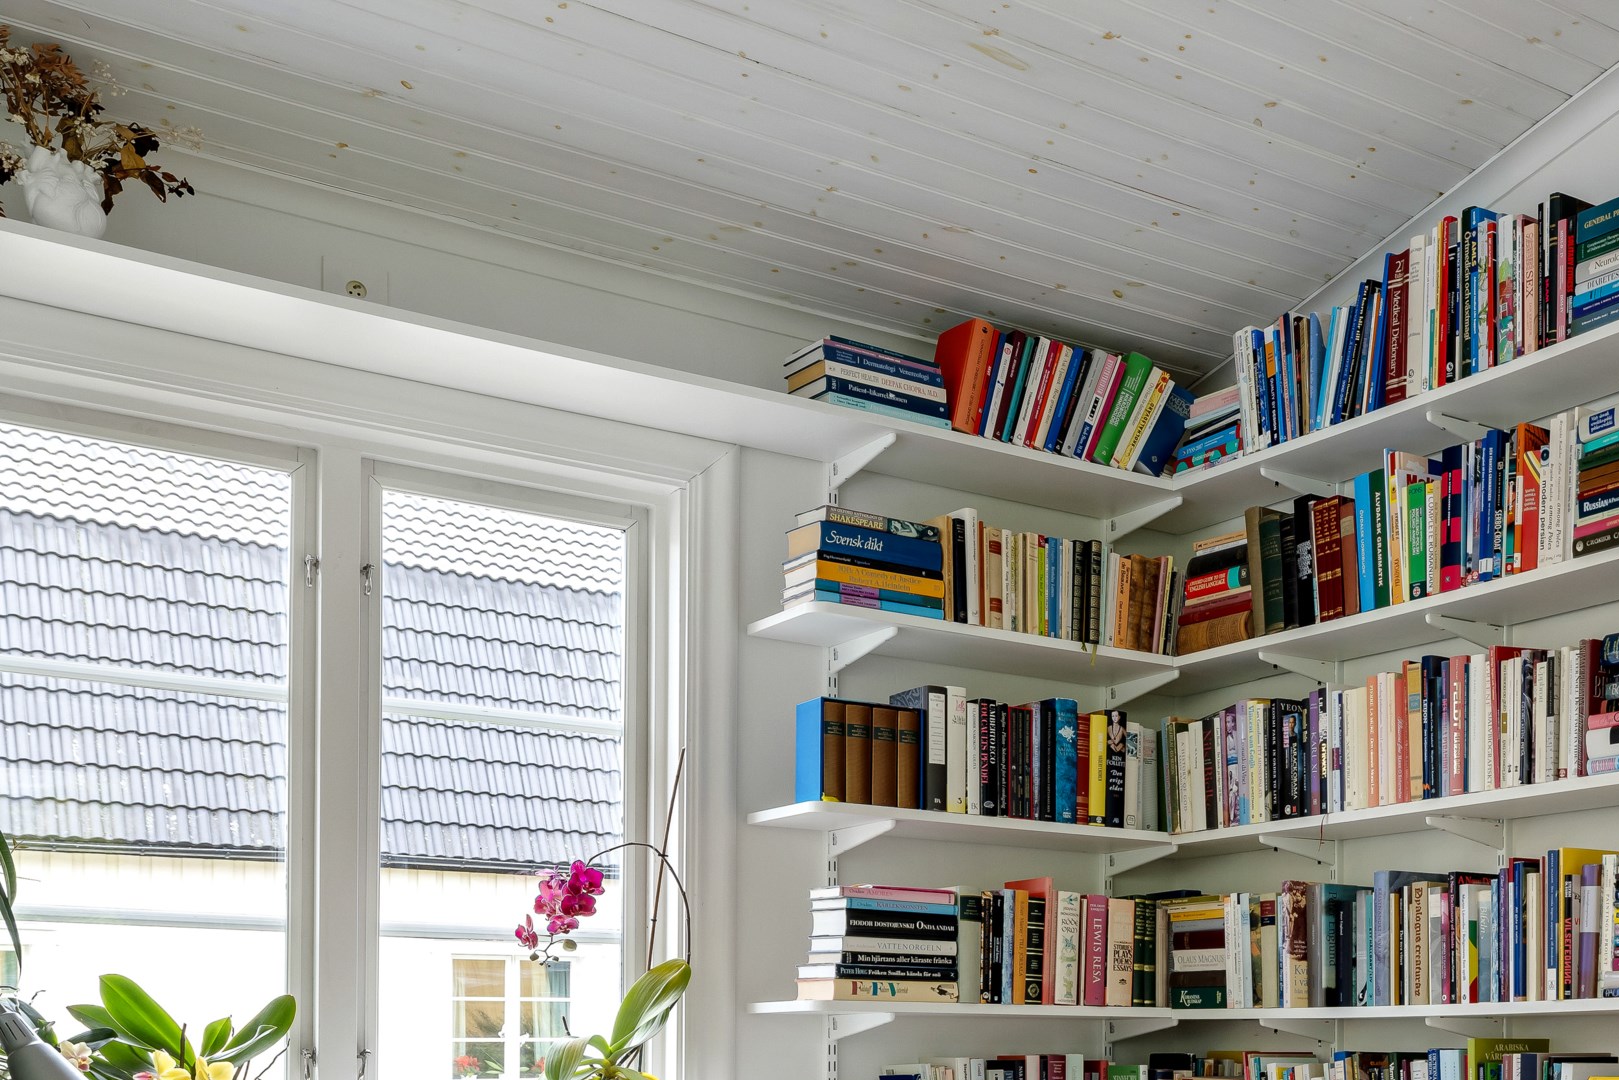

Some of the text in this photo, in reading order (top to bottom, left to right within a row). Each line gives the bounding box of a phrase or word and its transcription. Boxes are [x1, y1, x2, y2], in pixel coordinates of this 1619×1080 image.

[1584, 213, 1611, 229] GENERAL
[1463, 230, 1472, 282] Örtmedicin
[1462, 300, 1472, 340] växtmagi
[1390, 290, 1401, 377] Medical Dictionary
[840, 367, 879, 384] PERFECT HEALTH
[881, 376, 901, 389] DEEPAK
[1408, 486, 1422, 494] PONS
[829, 512, 884, 530] SHAKESPEARE
[826, 530, 884, 552] Svensk dikt
[1189, 579, 1226, 592] ENGLISH LANGUAGE
[1453, 682, 1462, 730] FELDT
[850, 920, 873, 928] FJODOR
[1480, 906, 1488, 934] Bibeln
[876, 942, 942, 952] VATTENORGELN
[1092, 918, 1102, 984] LEWIS RESA
[1113, 950, 1132, 958] PLAYS
[857, 954, 953, 964] Min hjärtans aller käraste fränka
[1177, 954, 1224, 964] OLAUS MAGNUS
[1112, 964, 1132, 972] ESSAYS
[1494, 1044, 1529, 1052] ARABISKA
